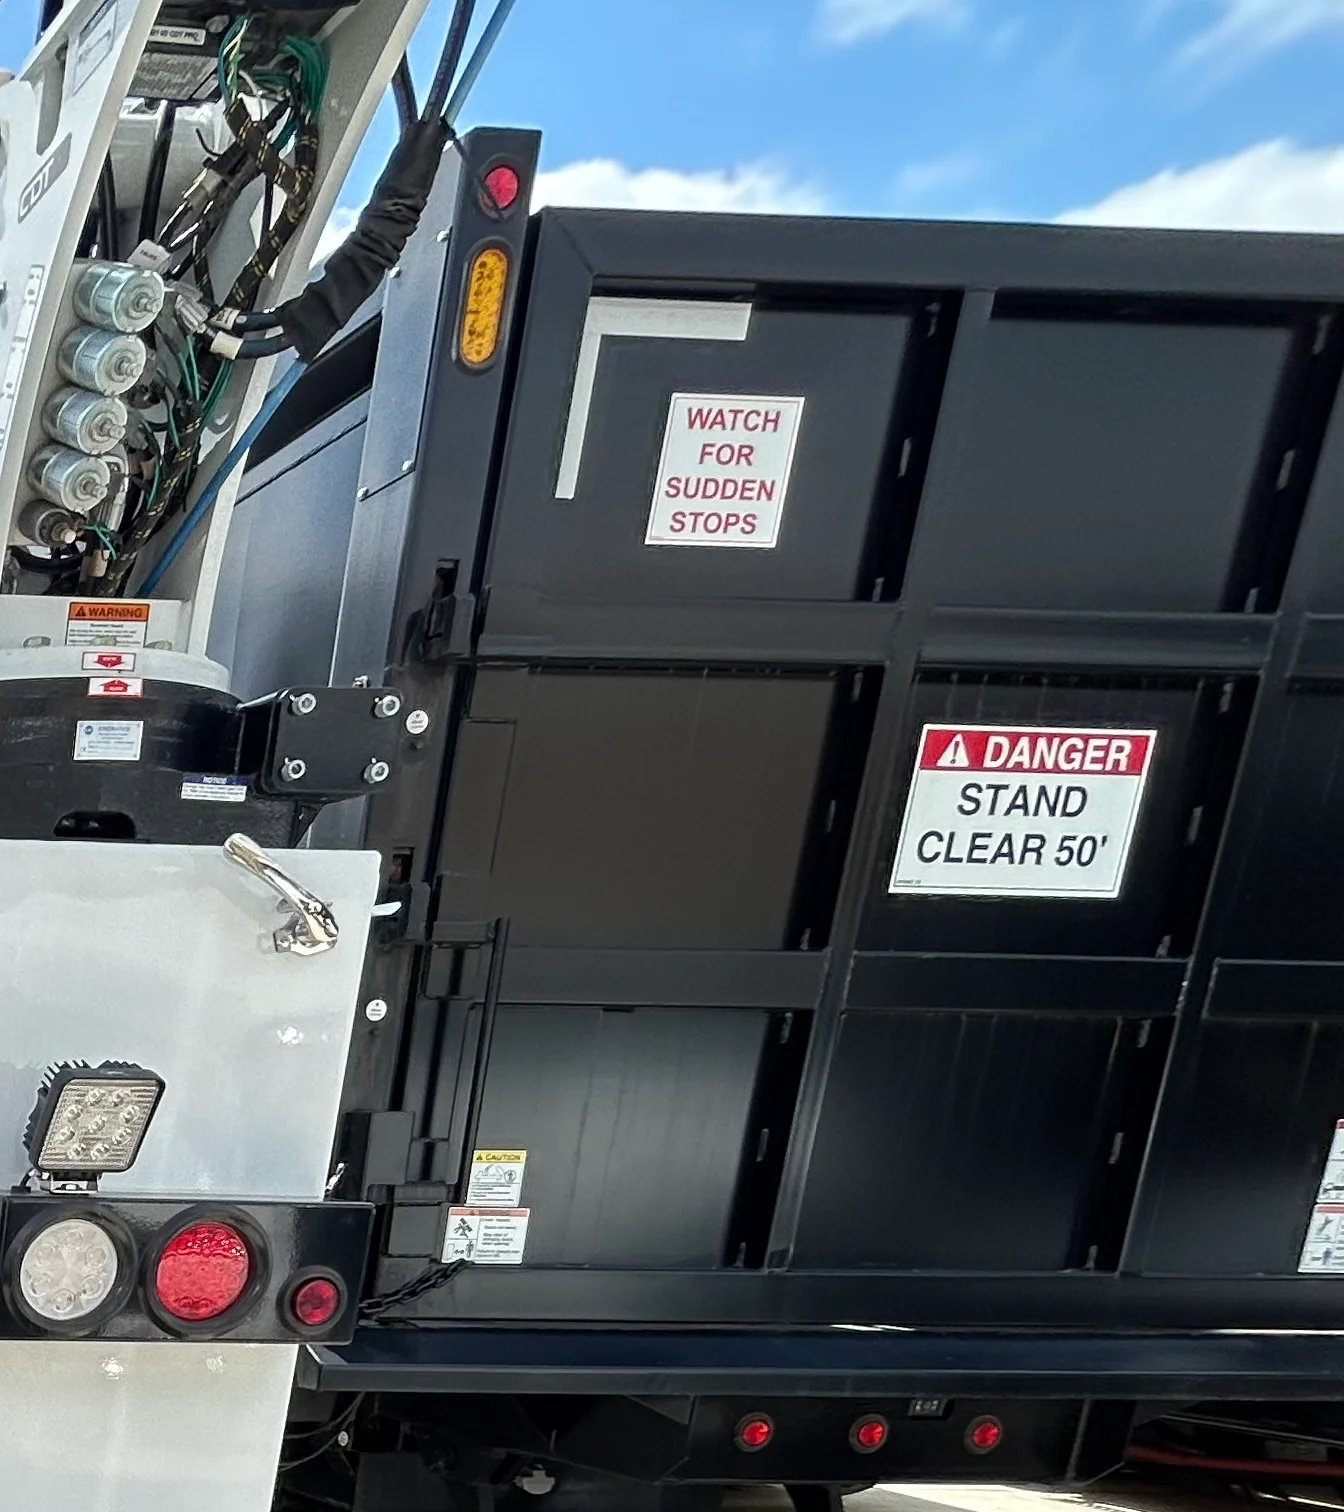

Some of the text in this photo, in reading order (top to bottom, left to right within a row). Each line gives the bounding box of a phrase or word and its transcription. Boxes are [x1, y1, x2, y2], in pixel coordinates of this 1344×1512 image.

[19, 156, 54, 217] CDT
[687, 407, 781, 433] WATCH
[698, 443, 754, 466] FOR
[664, 476, 776, 501] SUDDEN
[669, 511, 758, 535] STOPS
[88, 607, 143, 619] WARNING
[982, 735, 1133, 772] DANGER
[957, 782, 1088, 818] STAND
[916, 830, 1109, 867] CLEAR 50'
